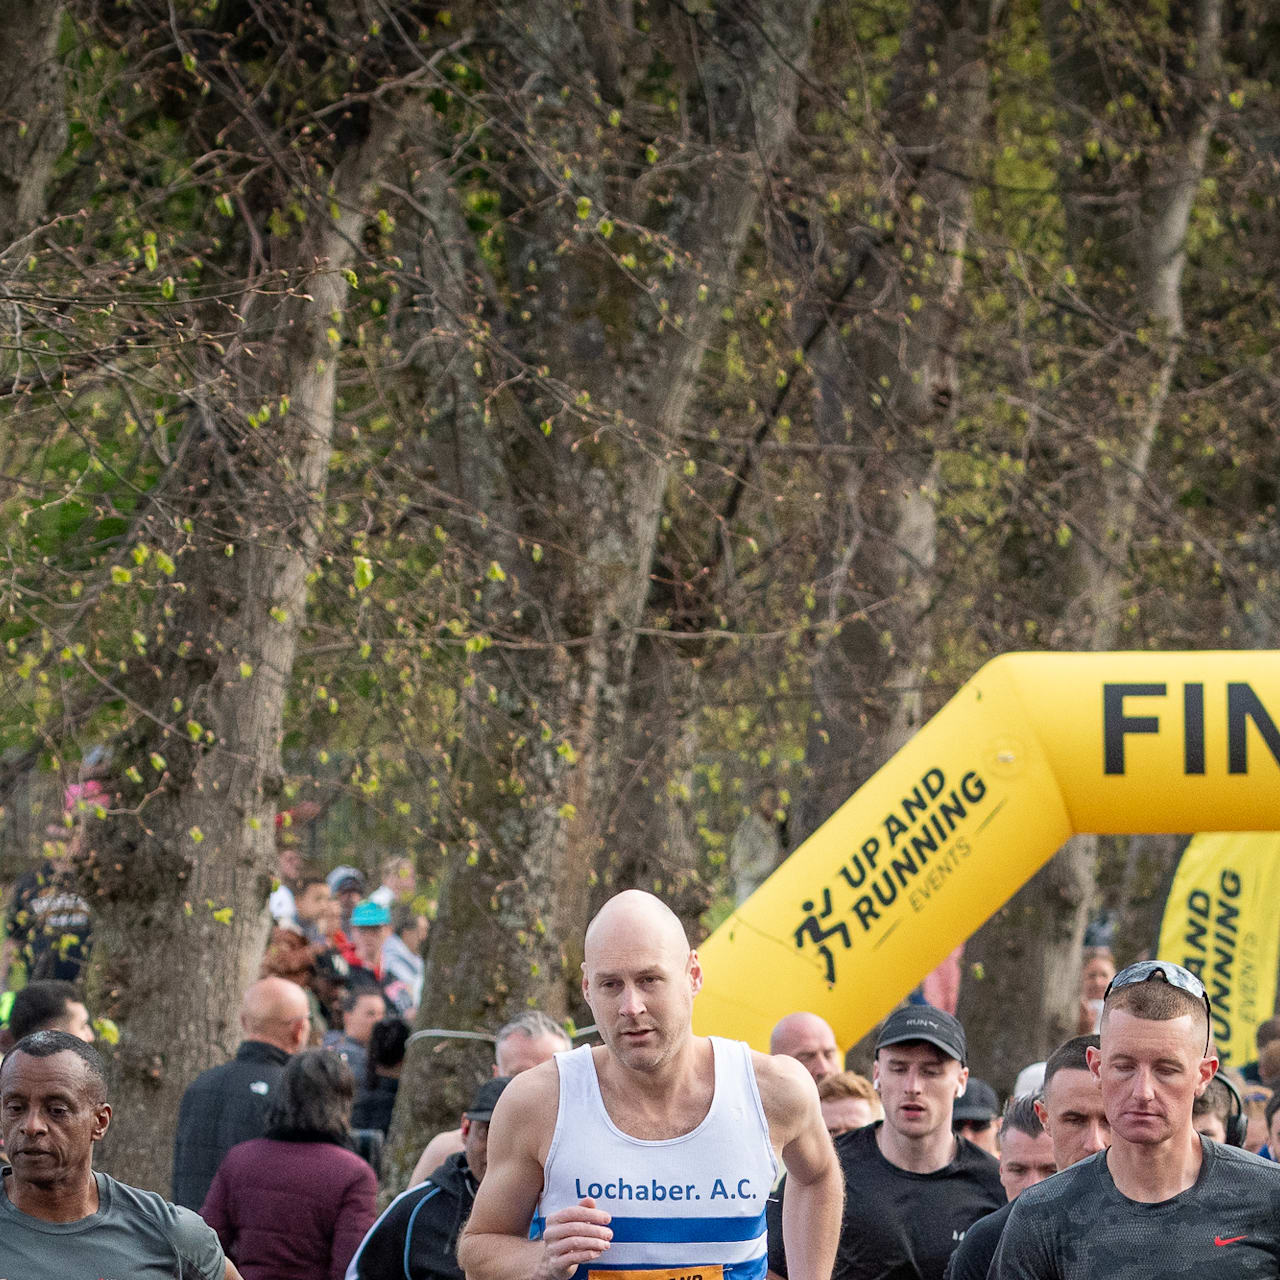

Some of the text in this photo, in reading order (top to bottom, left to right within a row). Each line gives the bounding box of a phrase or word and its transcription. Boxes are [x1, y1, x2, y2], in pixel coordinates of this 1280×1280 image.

[837, 767, 946, 889] UP AND
[852, 771, 987, 930] RUNNING
[908, 836, 972, 913] EVENTS
[575, 1177, 757, 1201] Lochaber. A.C.
